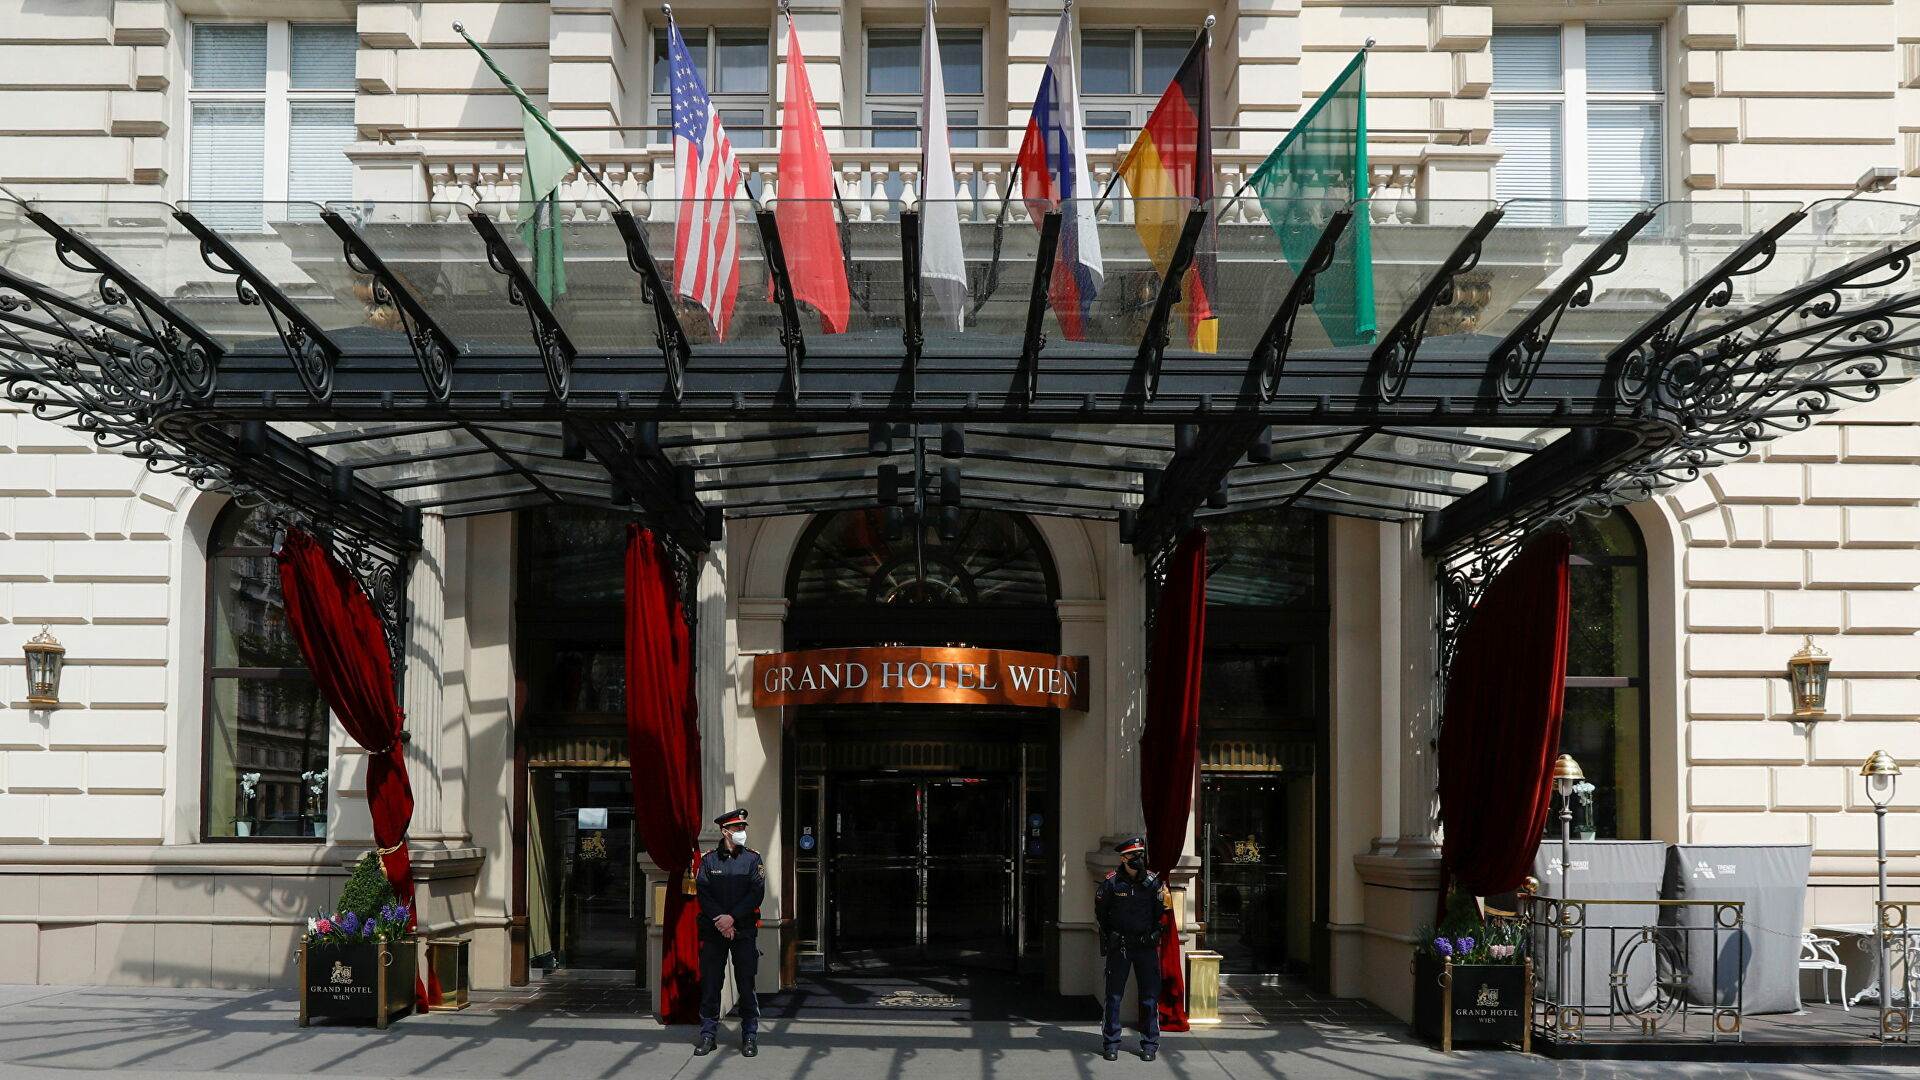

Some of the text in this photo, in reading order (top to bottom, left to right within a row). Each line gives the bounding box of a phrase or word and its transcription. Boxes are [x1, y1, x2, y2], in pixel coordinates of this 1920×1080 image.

[764, 662, 1078, 696] GRAND HOTEL WIEN
[344, 986, 373, 994] HOTEL
[1490, 1009, 1519, 1017] HOTEL
